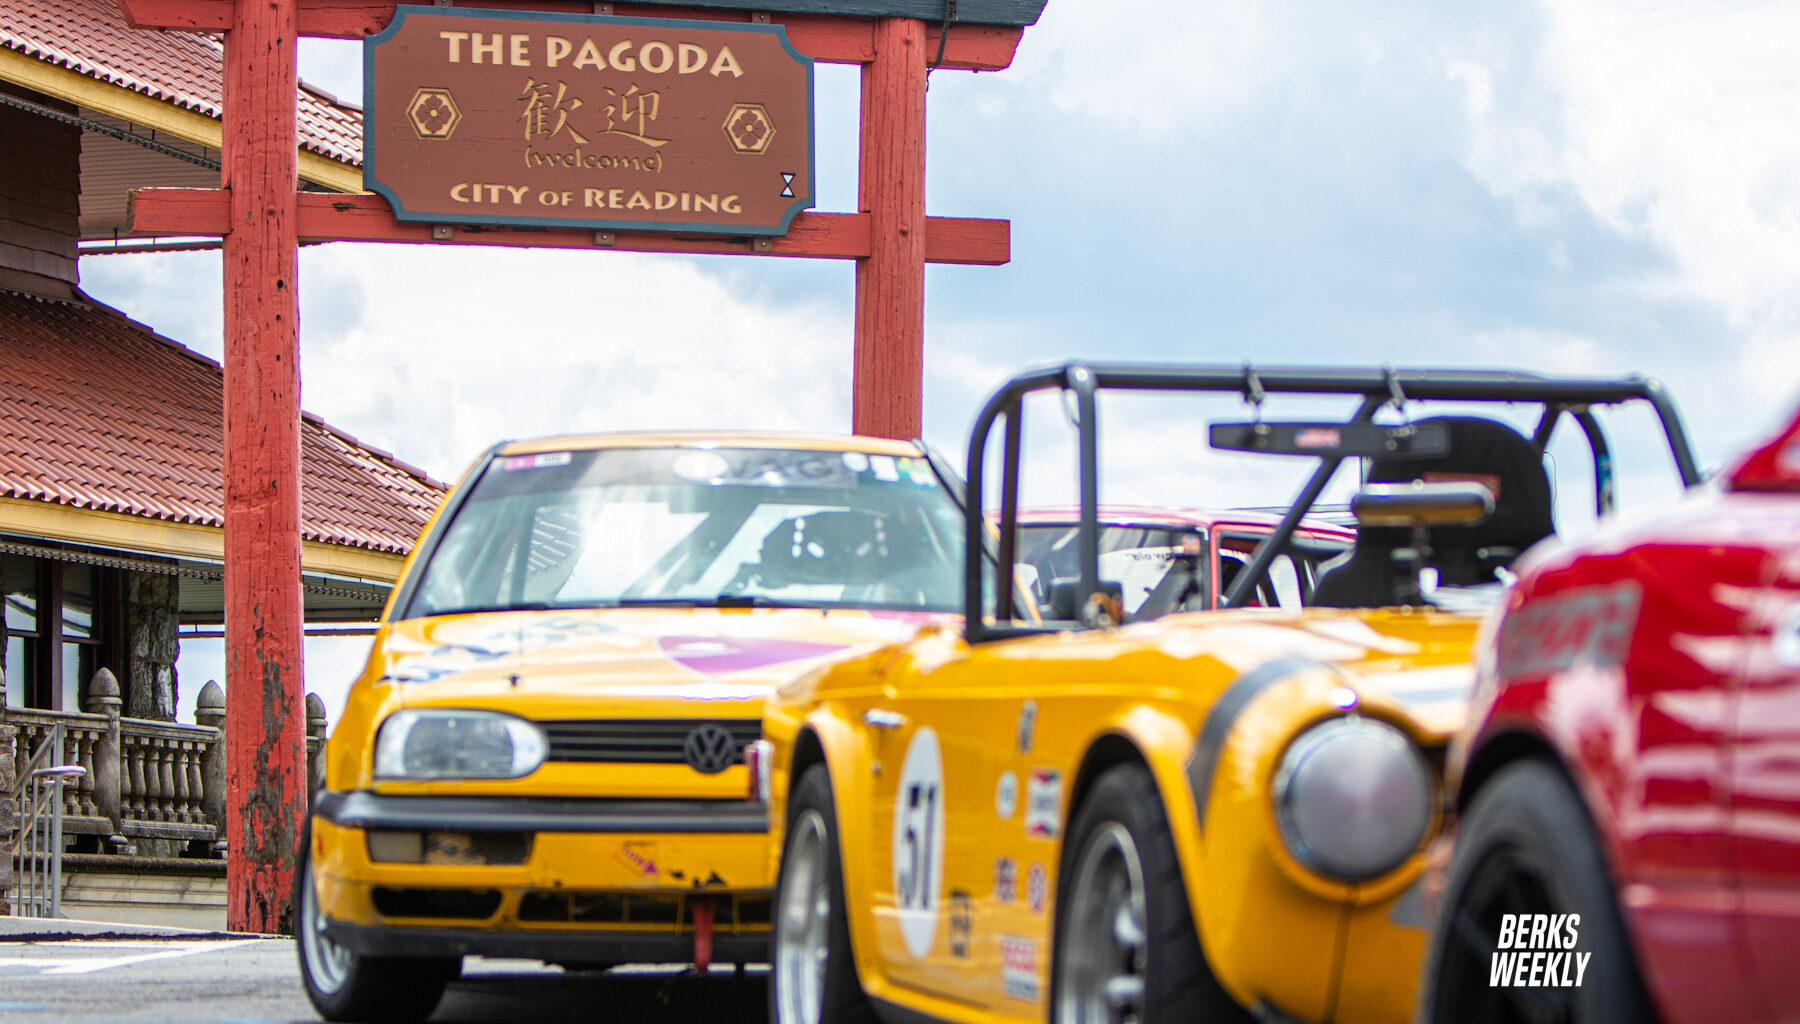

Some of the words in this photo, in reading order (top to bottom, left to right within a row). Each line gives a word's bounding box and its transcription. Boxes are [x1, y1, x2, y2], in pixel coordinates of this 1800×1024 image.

[440, 31, 531, 66] THE
[546, 36, 745, 78] PAGODA
[524, 147, 664, 173] (welcome)
[450, 183, 530, 205] CITY
[584, 189, 742, 214] READING
[898, 780, 938, 909] 51
